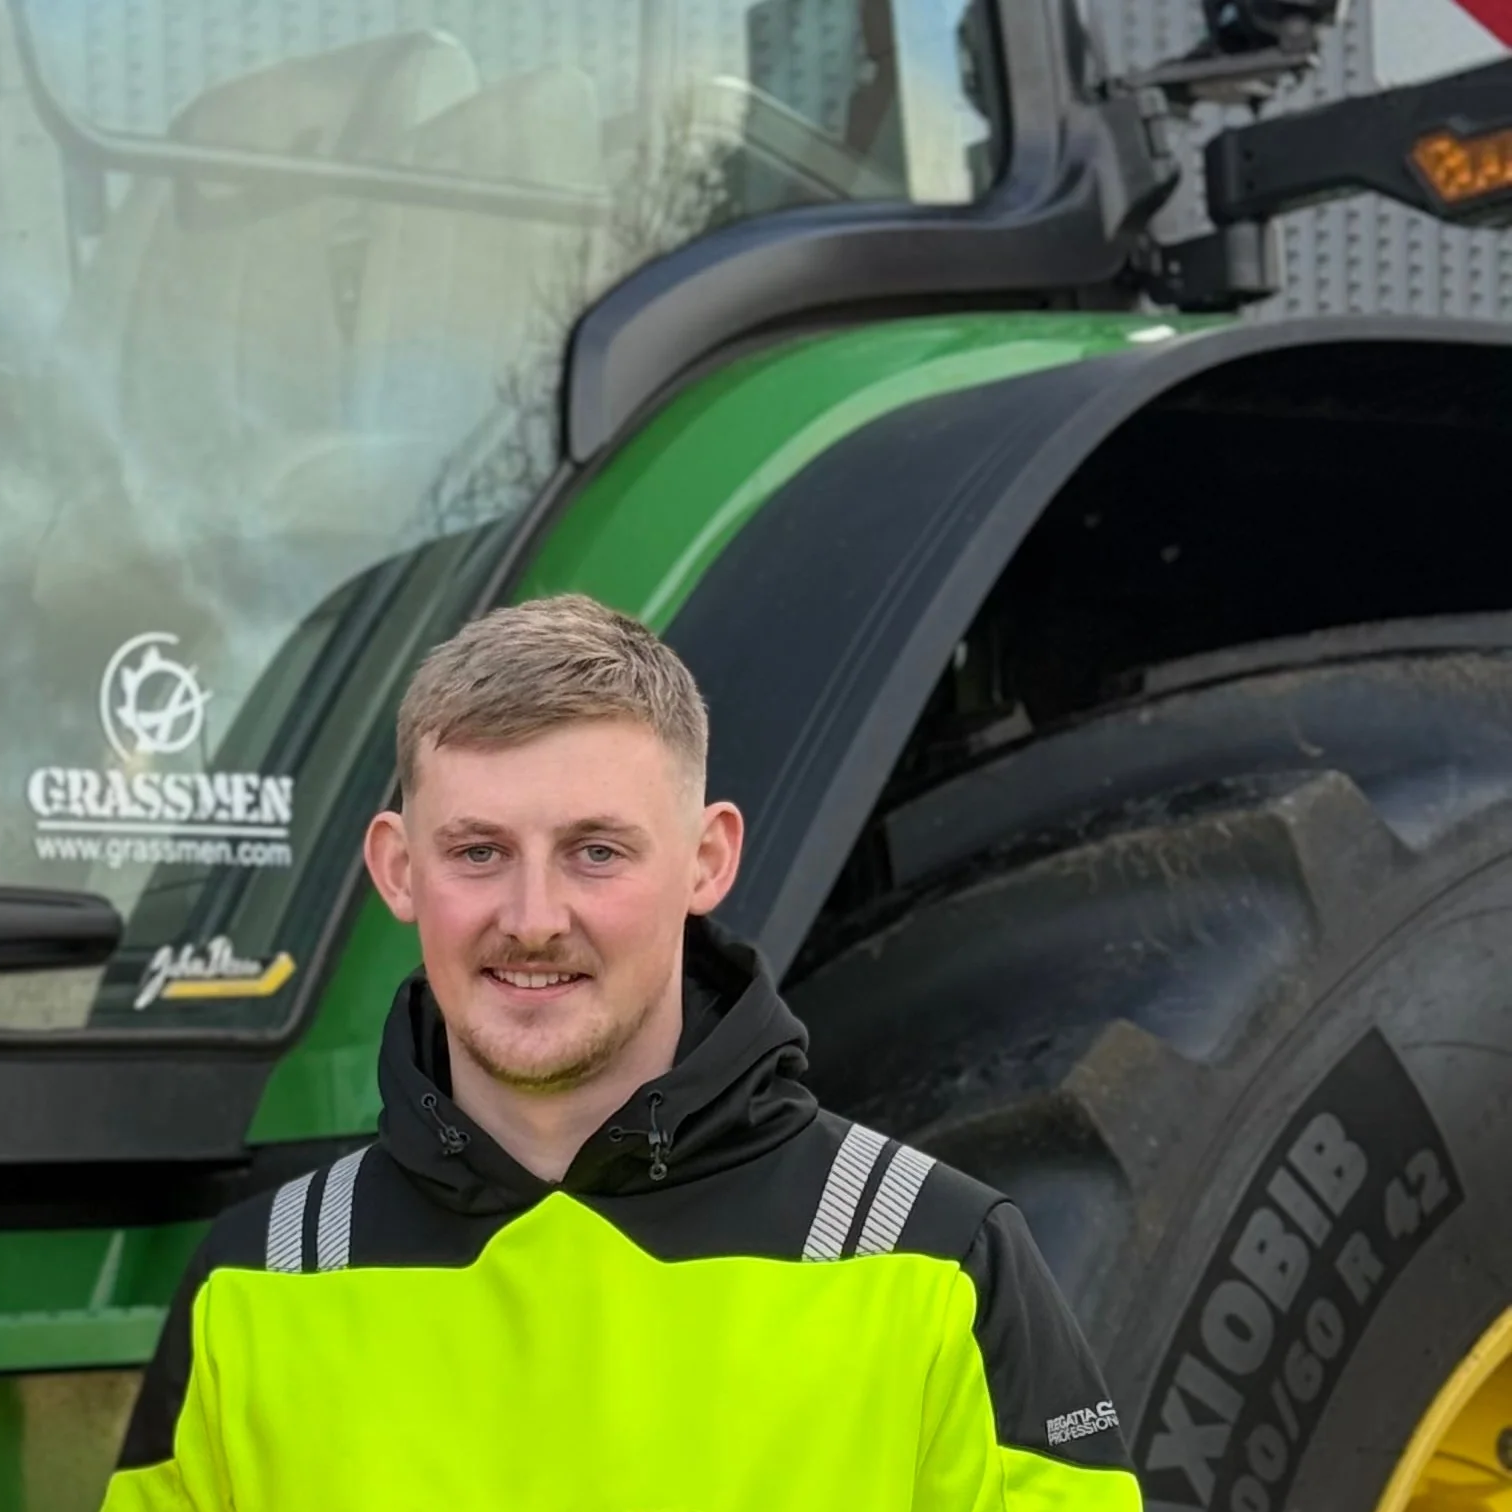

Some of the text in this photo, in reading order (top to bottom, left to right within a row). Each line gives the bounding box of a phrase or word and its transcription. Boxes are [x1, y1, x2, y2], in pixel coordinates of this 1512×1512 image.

[28, 766, 294, 824] GRASSMEN
[35, 837, 292, 869] www.grassmen.com
[1334, 1231, 1385, 1306] R
[1384, 1148, 1450, 1240] 42
